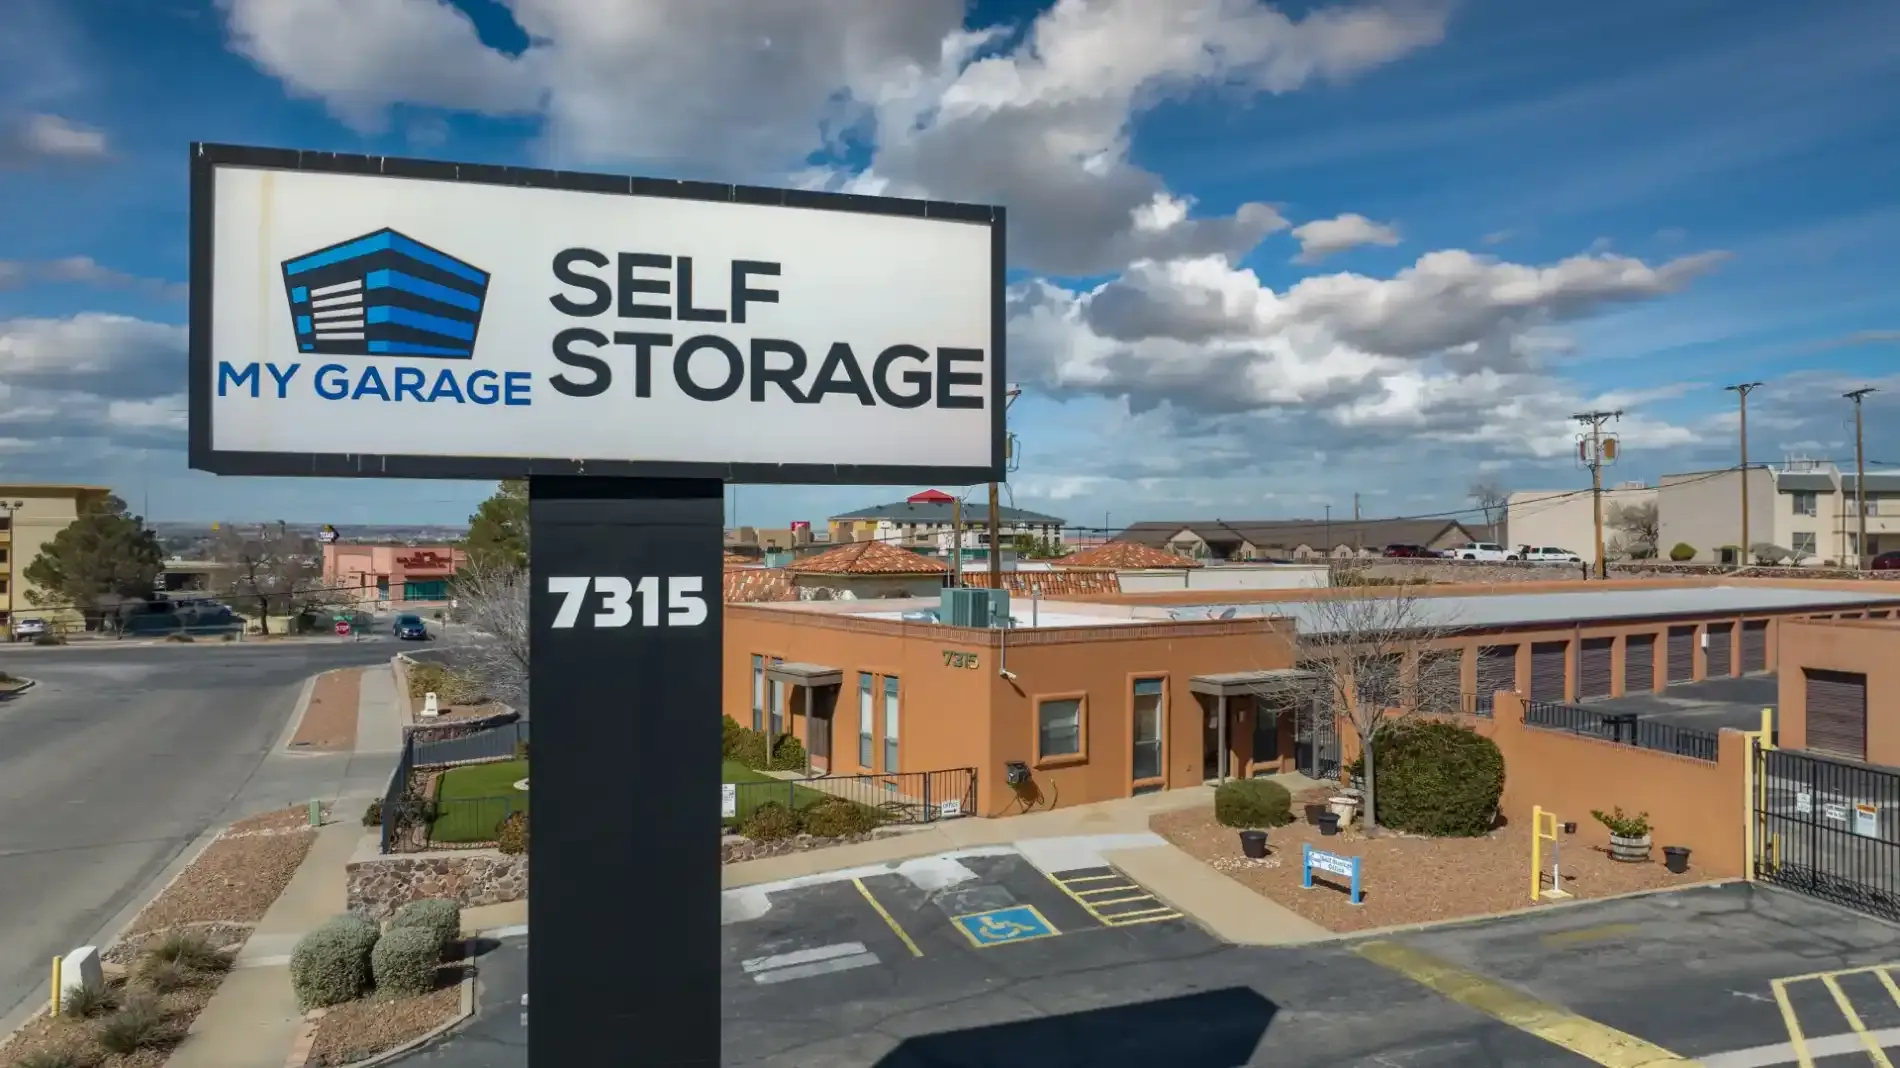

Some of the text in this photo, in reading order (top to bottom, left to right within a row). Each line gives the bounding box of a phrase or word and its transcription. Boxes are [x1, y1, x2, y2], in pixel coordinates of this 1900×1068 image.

[548, 247, 781, 324] SELF
[217, 360, 533, 407] MY GARAGE
[548, 327, 985, 411] STORAGE
[548, 576, 708, 629] 7315
[942, 650, 979, 669] 7315
